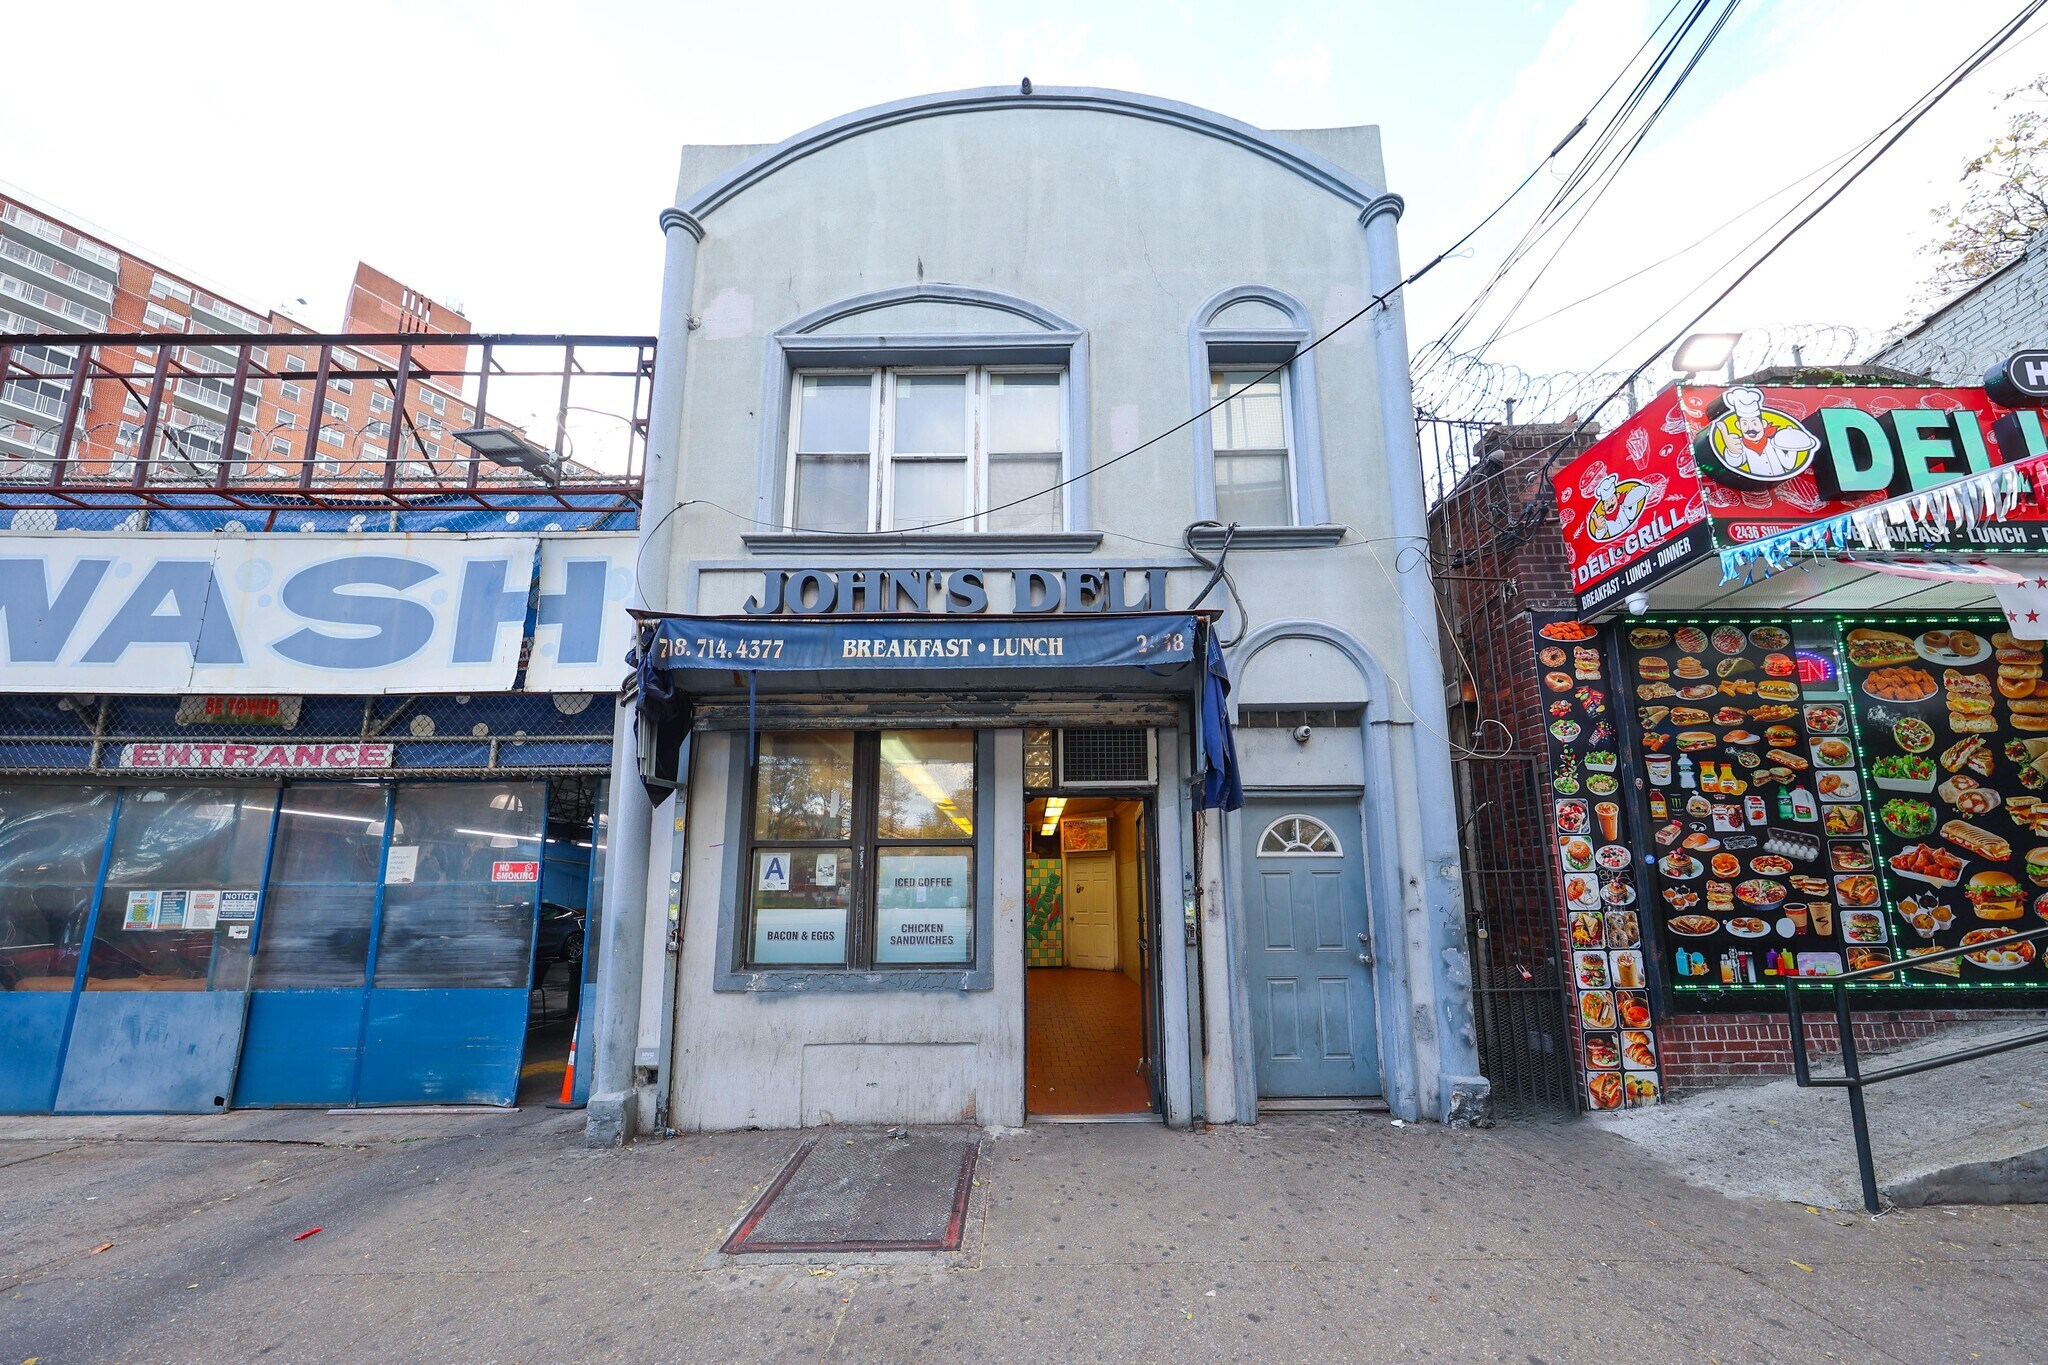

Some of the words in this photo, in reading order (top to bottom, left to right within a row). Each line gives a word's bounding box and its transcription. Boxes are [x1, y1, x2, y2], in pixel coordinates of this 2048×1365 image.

[1624, 508, 1685, 555] GRILL
[1735, 525, 1759, 539] 2436
[1967, 526, 2028, 544] LUNCH
[1581, 577, 1620, 610] BREAKFAST
[1625, 559, 1652, 586] LUNCH
[1657, 537, 1691, 568] DINNER
[742, 568, 988, 614] JOHN'S
[1011, 568, 1169, 613] DELI
[842, 638, 972, 658] BREAKFAST
[992, 637, 1064, 656] LUNCH
[205, 697, 224, 715] BE
[228, 697, 279, 717] TOWED
[132, 744, 388, 767] ENTRANCE
[496, 871, 534, 880] SMOKING
[499, 863, 510, 871] NO
[764, 857, 785, 880] A
[894, 877, 915, 887] ICED
[918, 877, 952, 887] COFFEE
[767, 931, 799, 941] BACON
[801, 931, 808, 941] &
[811, 931, 835, 941] EGGS
[901, 923, 944, 933] CHICKEN
[890, 935, 954, 946] SANDWICHES
